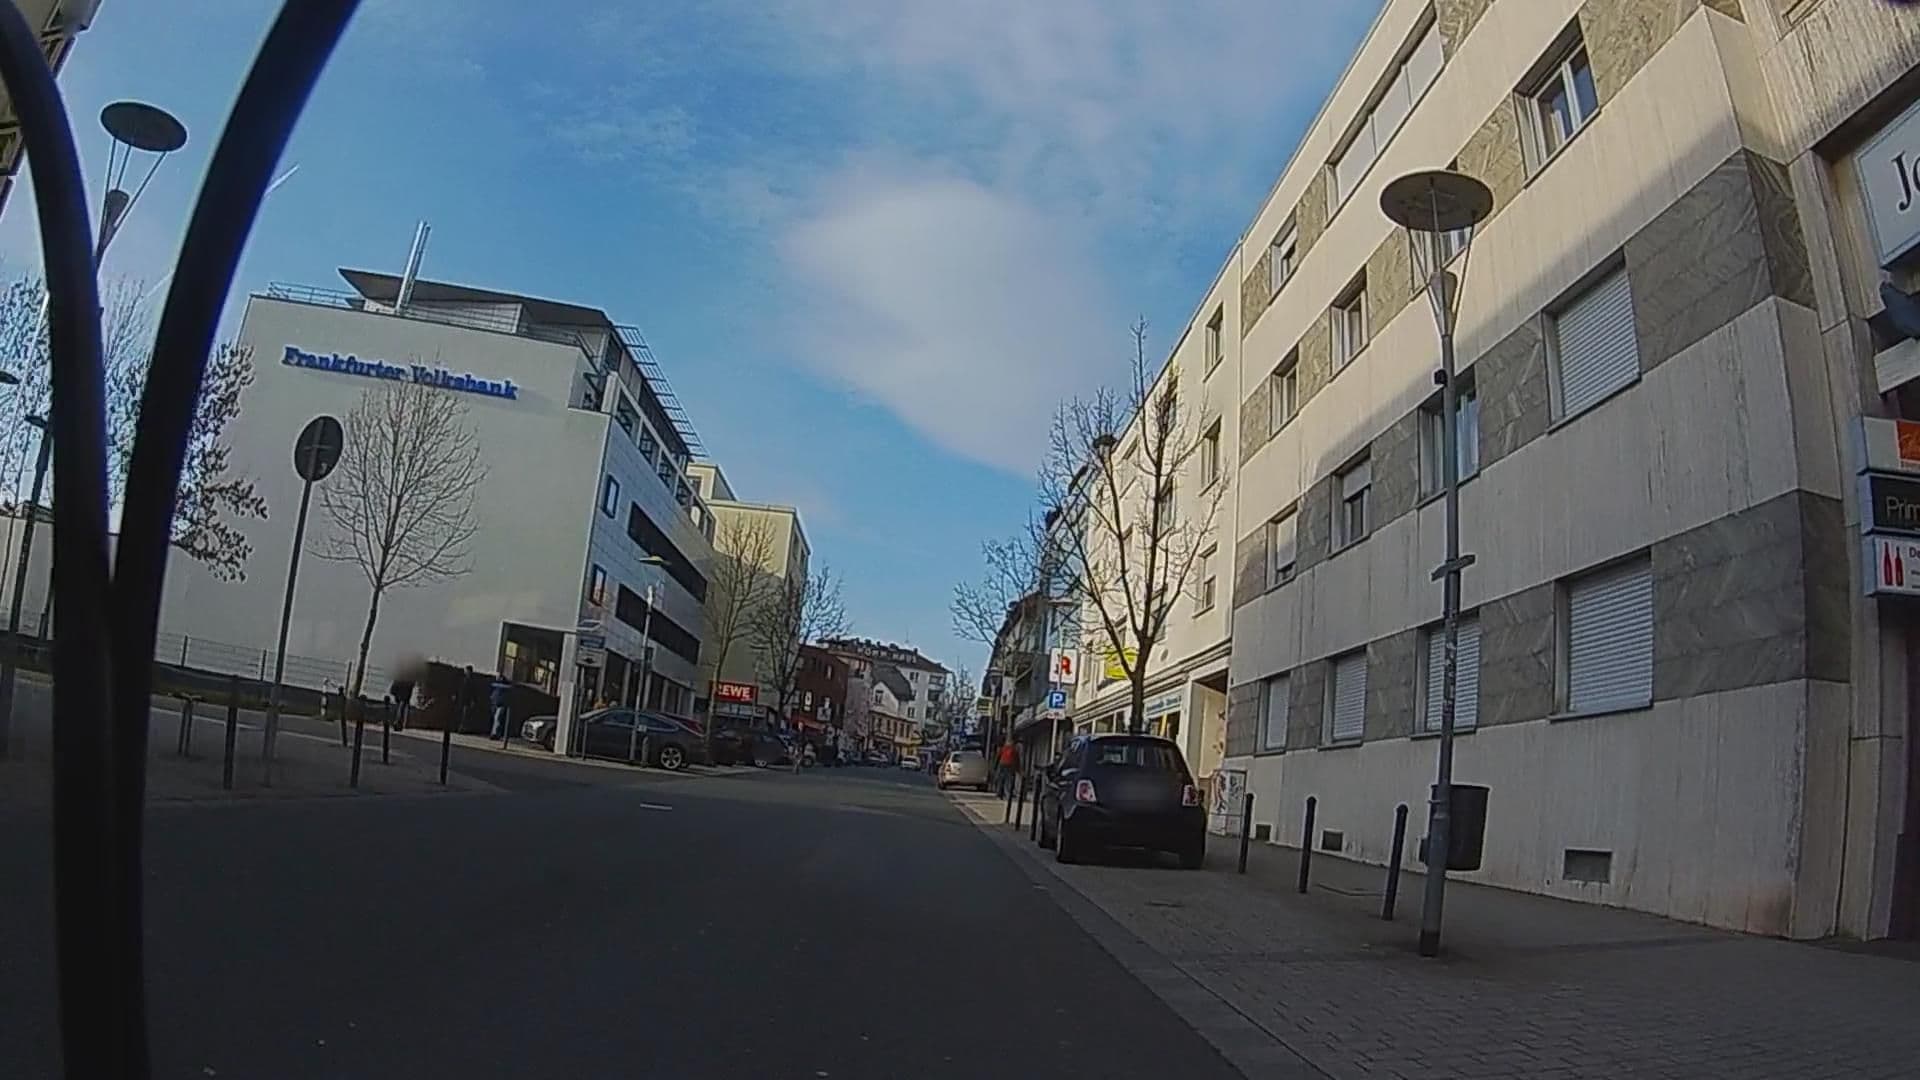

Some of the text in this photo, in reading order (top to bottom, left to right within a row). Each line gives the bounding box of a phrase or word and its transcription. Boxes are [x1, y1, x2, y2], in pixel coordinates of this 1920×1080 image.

[1890, 149, 1920, 211] J
[281, 347, 518, 400] Frankfurter Volksbank
